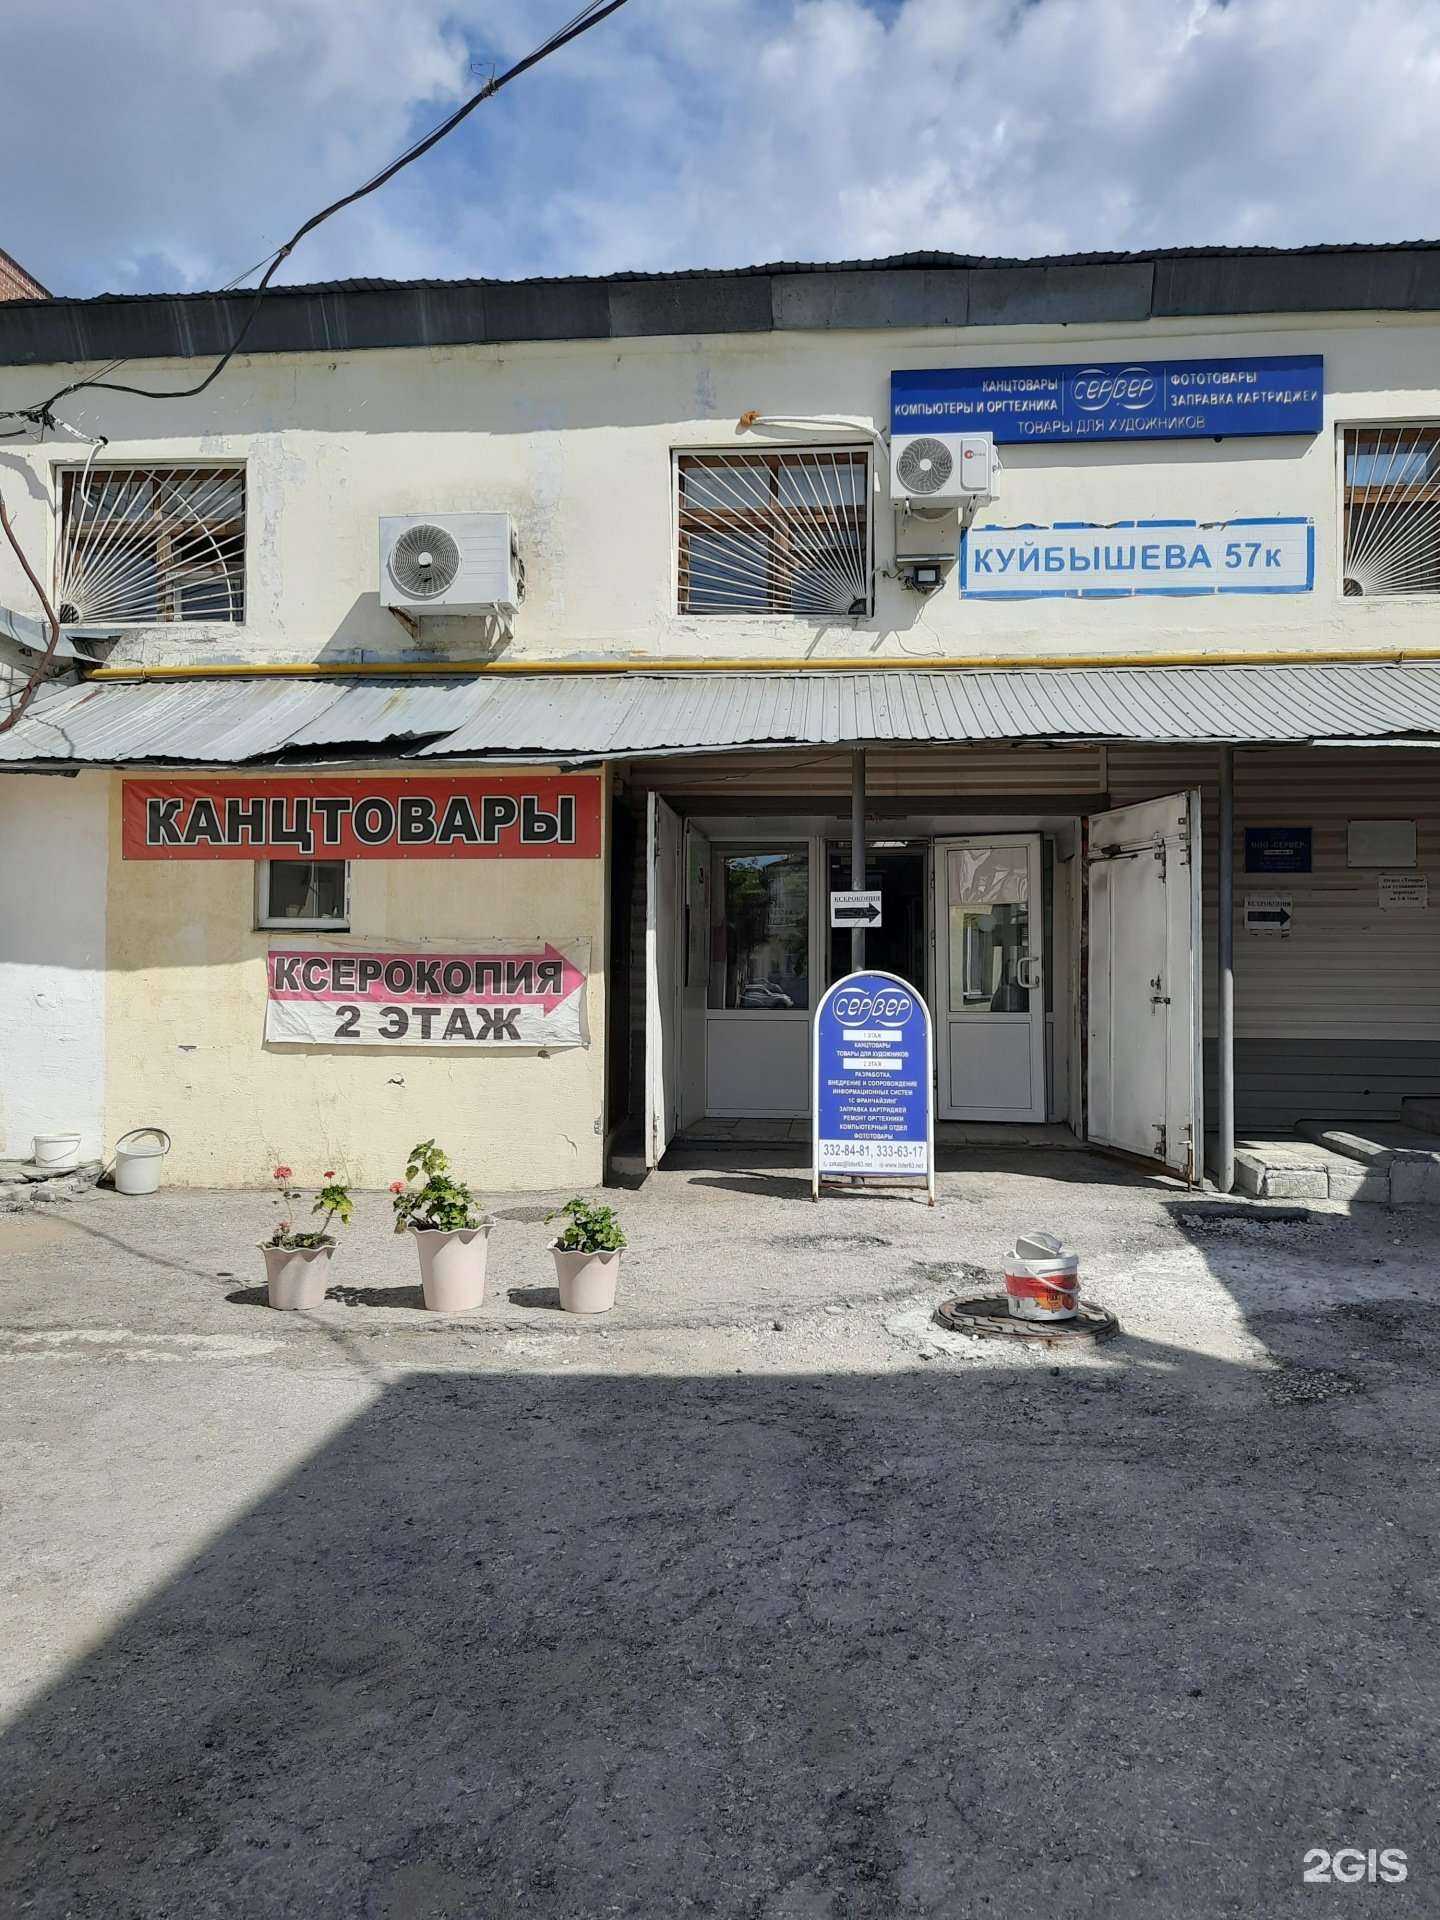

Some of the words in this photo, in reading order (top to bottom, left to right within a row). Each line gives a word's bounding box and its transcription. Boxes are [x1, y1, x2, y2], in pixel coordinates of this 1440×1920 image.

[982, 378, 1058, 393] КАНЦТОВАРЫ
[1170, 371, 1257, 386] ФОТОТОВАРЫ
[894, 402, 974, 416] КОМПЬЮТЕРЫ
[976, 402, 984, 413] И
[986, 399, 1058, 413] ОРГТЕХНИКА
[1170, 393, 1234, 407] ЗАПРАВКА
[1016, 420, 1073, 434] ТОВАРЫ
[1076, 419, 1105, 434] ДЛЯ
[1108, 415, 1206, 432] ХУДОЖНИКОВ
[973, 541, 1212, 574] КУЙБЫШЕВА
[1224, 543, 1282, 569] 57к
[146, 795, 576, 854] КАНЦТОВАРЫ
[273, 956, 565, 996] КСЕРОКОПИЯ
[334, 1006, 361, 1038] 2
[378, 1006, 522, 1040] ЭТАЖ
[823, 1144, 873, 1158] 332-84-81,
[876, 1145, 924, 1158] 333-63-17
